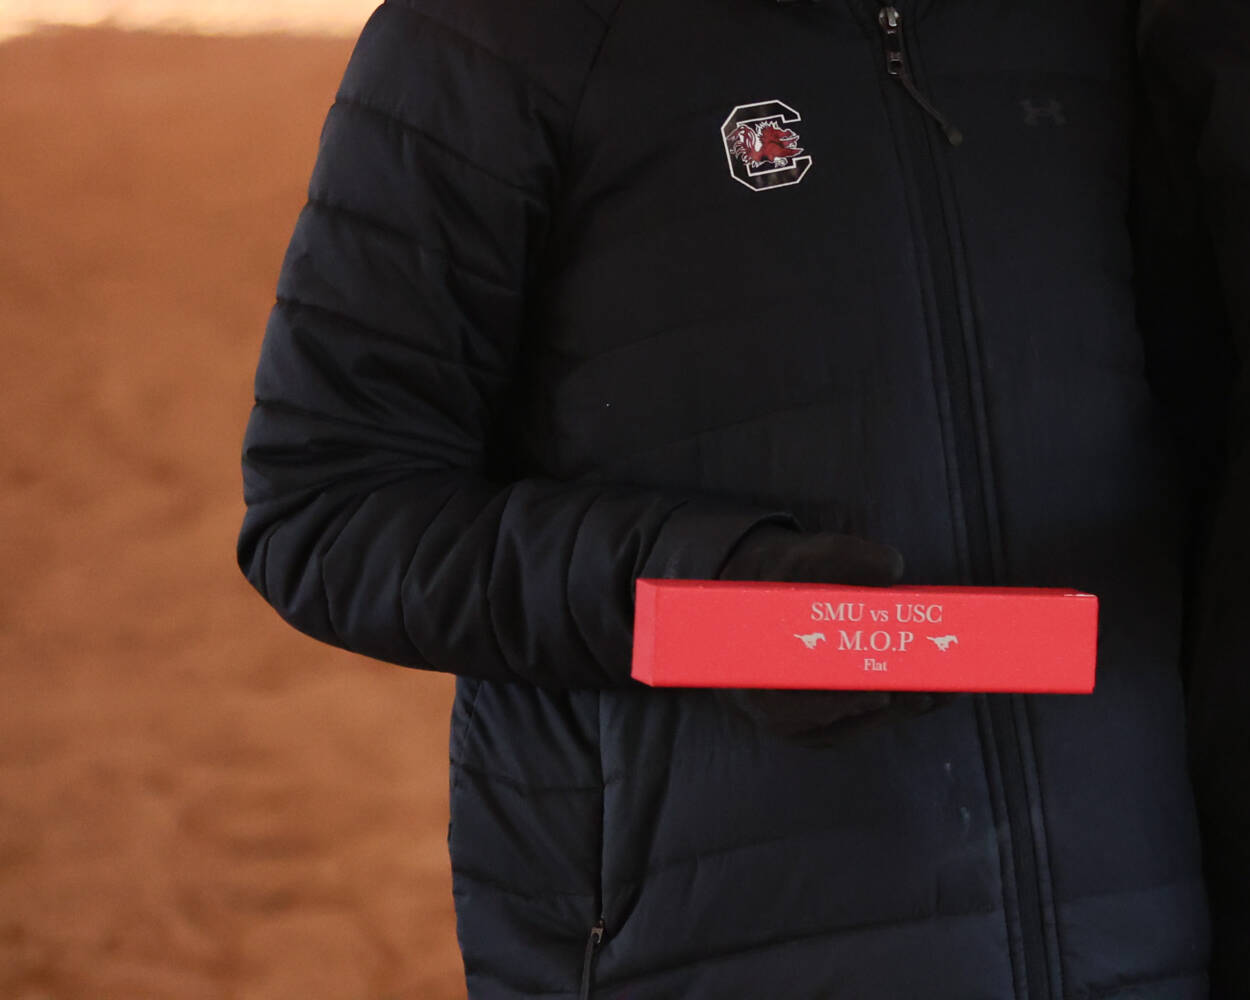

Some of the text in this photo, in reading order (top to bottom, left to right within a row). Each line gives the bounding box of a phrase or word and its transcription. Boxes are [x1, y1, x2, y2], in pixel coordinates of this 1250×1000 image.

[809, 602, 944, 624] SMU vs USC
[836, 629, 915, 653] M.O.P
[862, 657, 888, 672] Flat
